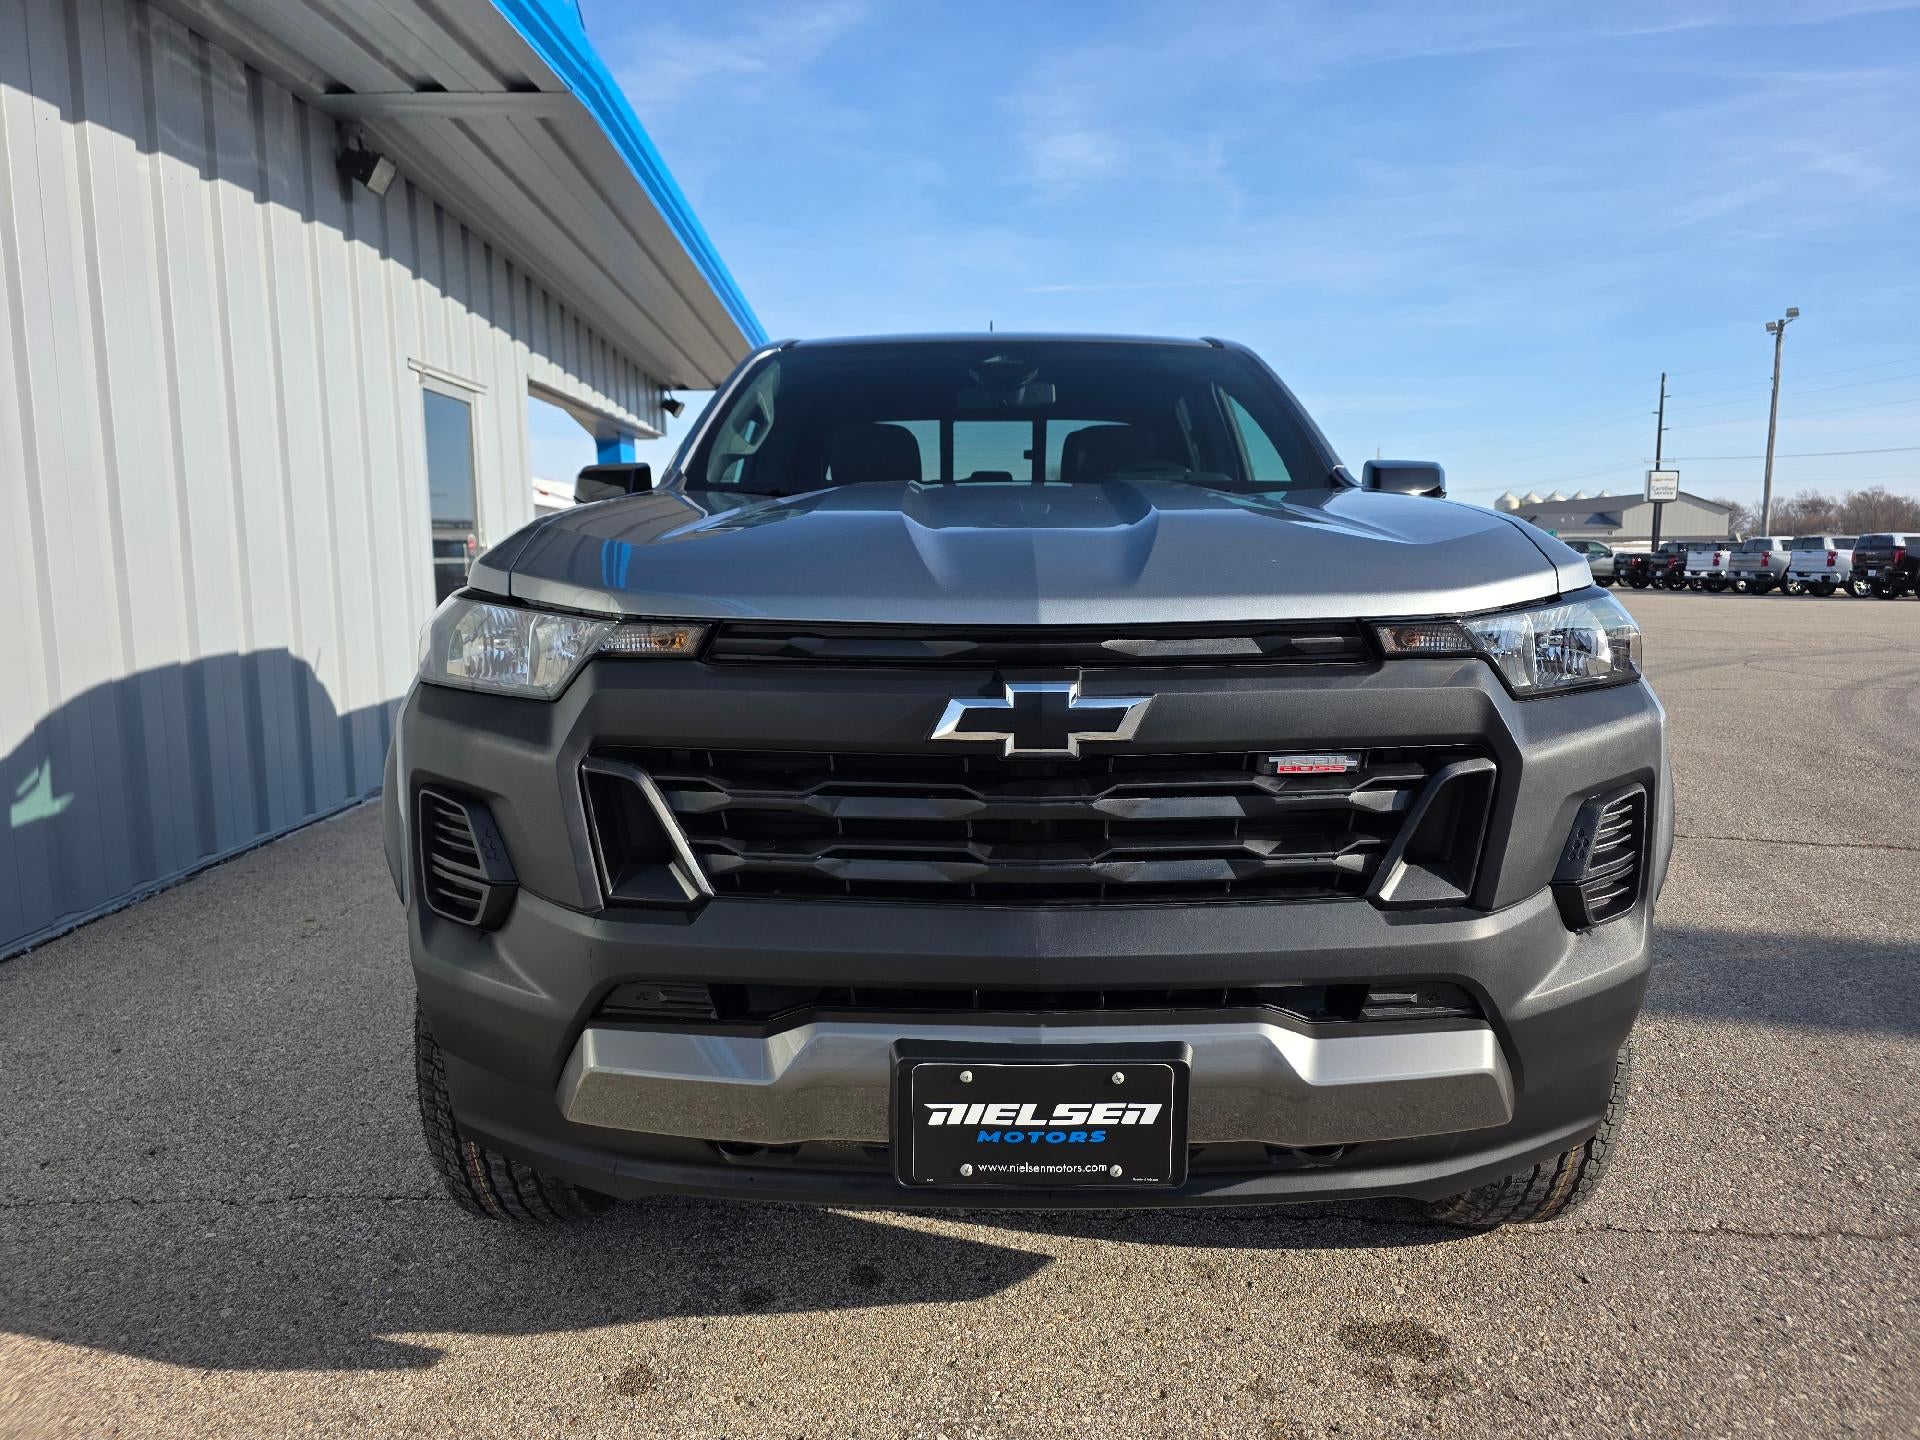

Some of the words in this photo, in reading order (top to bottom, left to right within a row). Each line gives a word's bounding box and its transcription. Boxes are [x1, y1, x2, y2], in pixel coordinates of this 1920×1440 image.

[1278, 765, 1346, 773] BOSS
[924, 1103, 1163, 1126] NIELSEN
[977, 1130, 1107, 1144] MOTORS
[978, 1162, 1108, 1174] www.nielsenmotors.com
